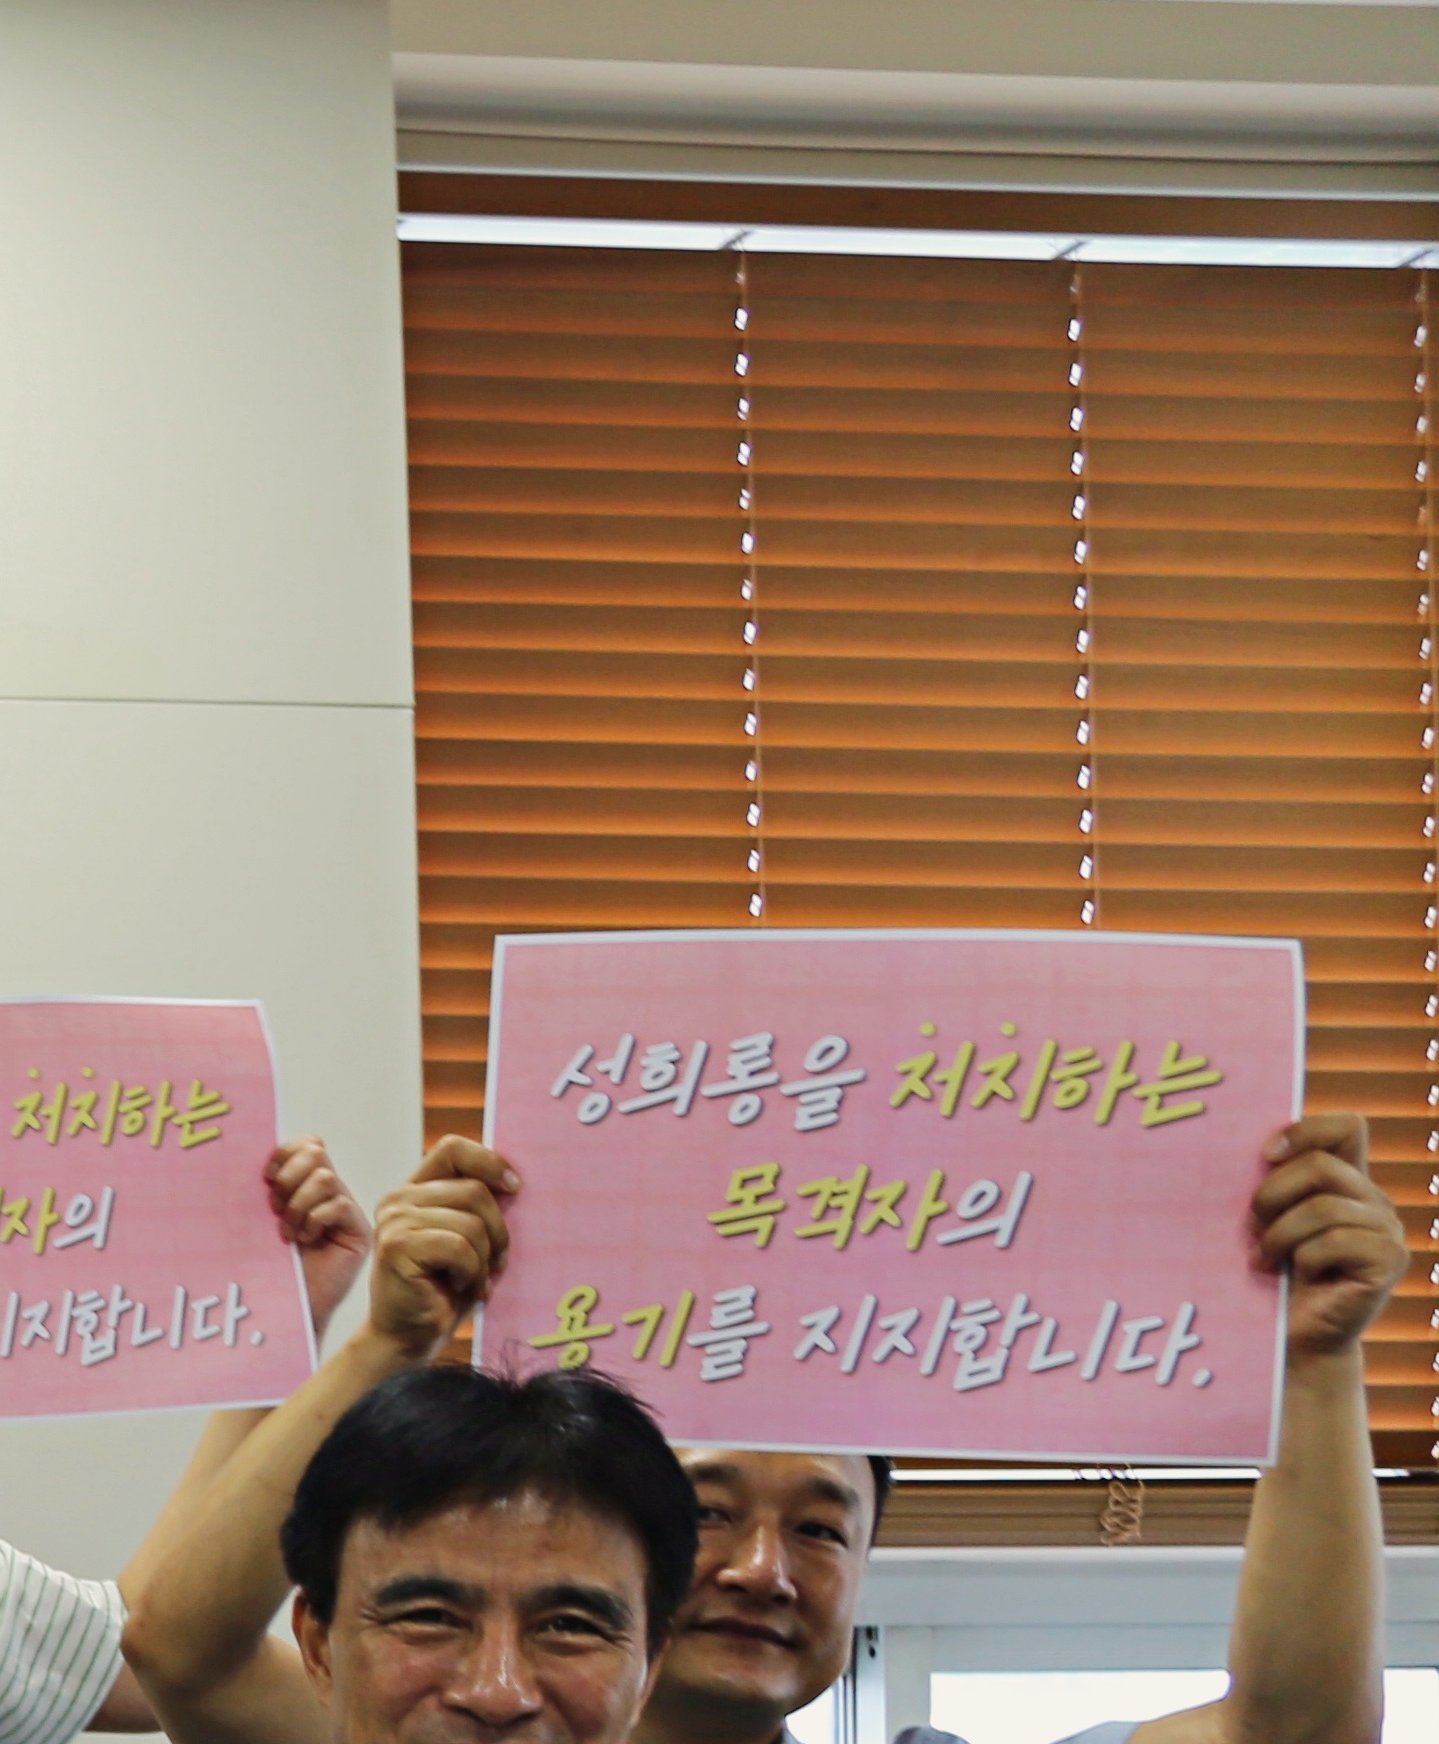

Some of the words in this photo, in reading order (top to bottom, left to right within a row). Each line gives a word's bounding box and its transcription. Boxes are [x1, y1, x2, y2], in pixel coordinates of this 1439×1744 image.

[11, 1080, 230, 1148] 저지하는
[551, 1032, 865, 1131] 성희롱을
[889, 1039, 1221, 1127] 저지하는
[708, 1161, 1032, 1251] 목격자의
[528, 1284, 769, 1381] 용기를
[792, 1292, 1212, 1391] 지지합니다.
